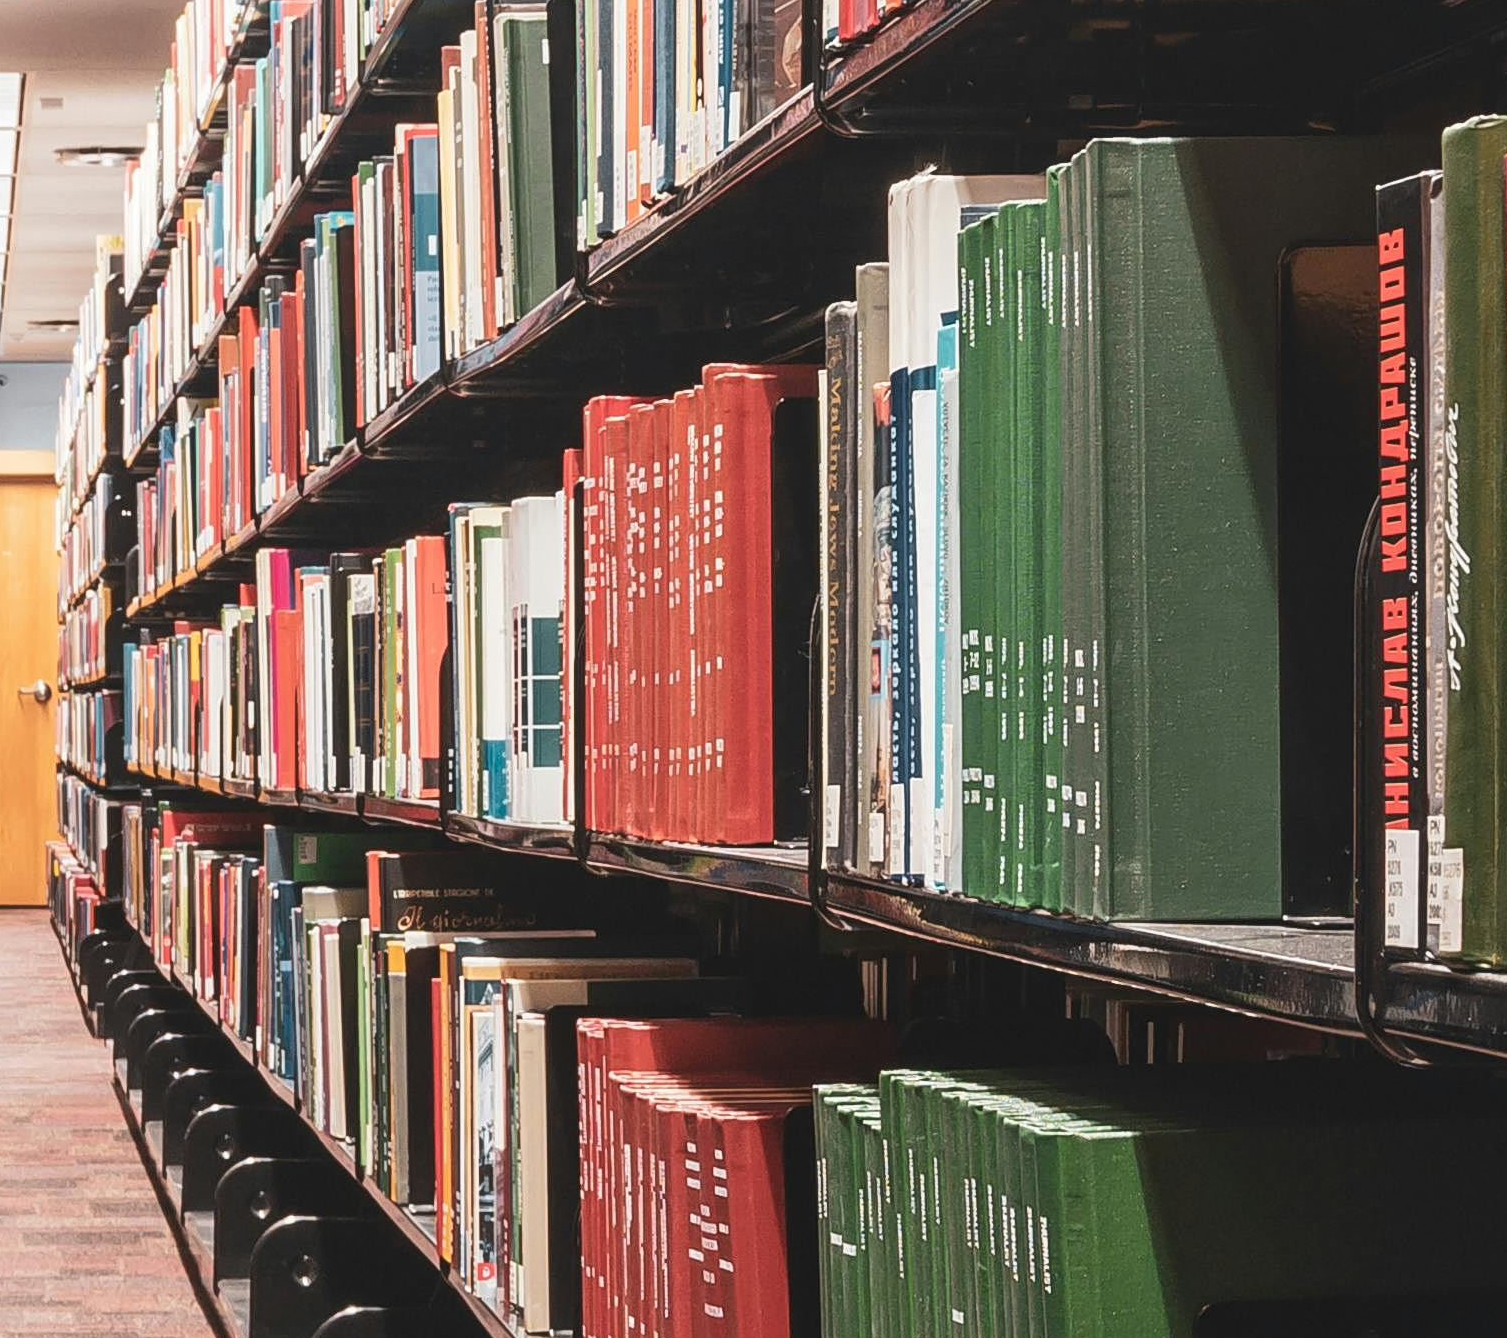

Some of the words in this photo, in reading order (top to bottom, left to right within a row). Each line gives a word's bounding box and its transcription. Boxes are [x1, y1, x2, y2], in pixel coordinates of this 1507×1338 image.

[827, 373, 842, 493] Making
[1378, 227, 1409, 574] КОНДРАШОВ
[827, 499, 840, 581] Jews
[826, 586, 841, 696] Modern
